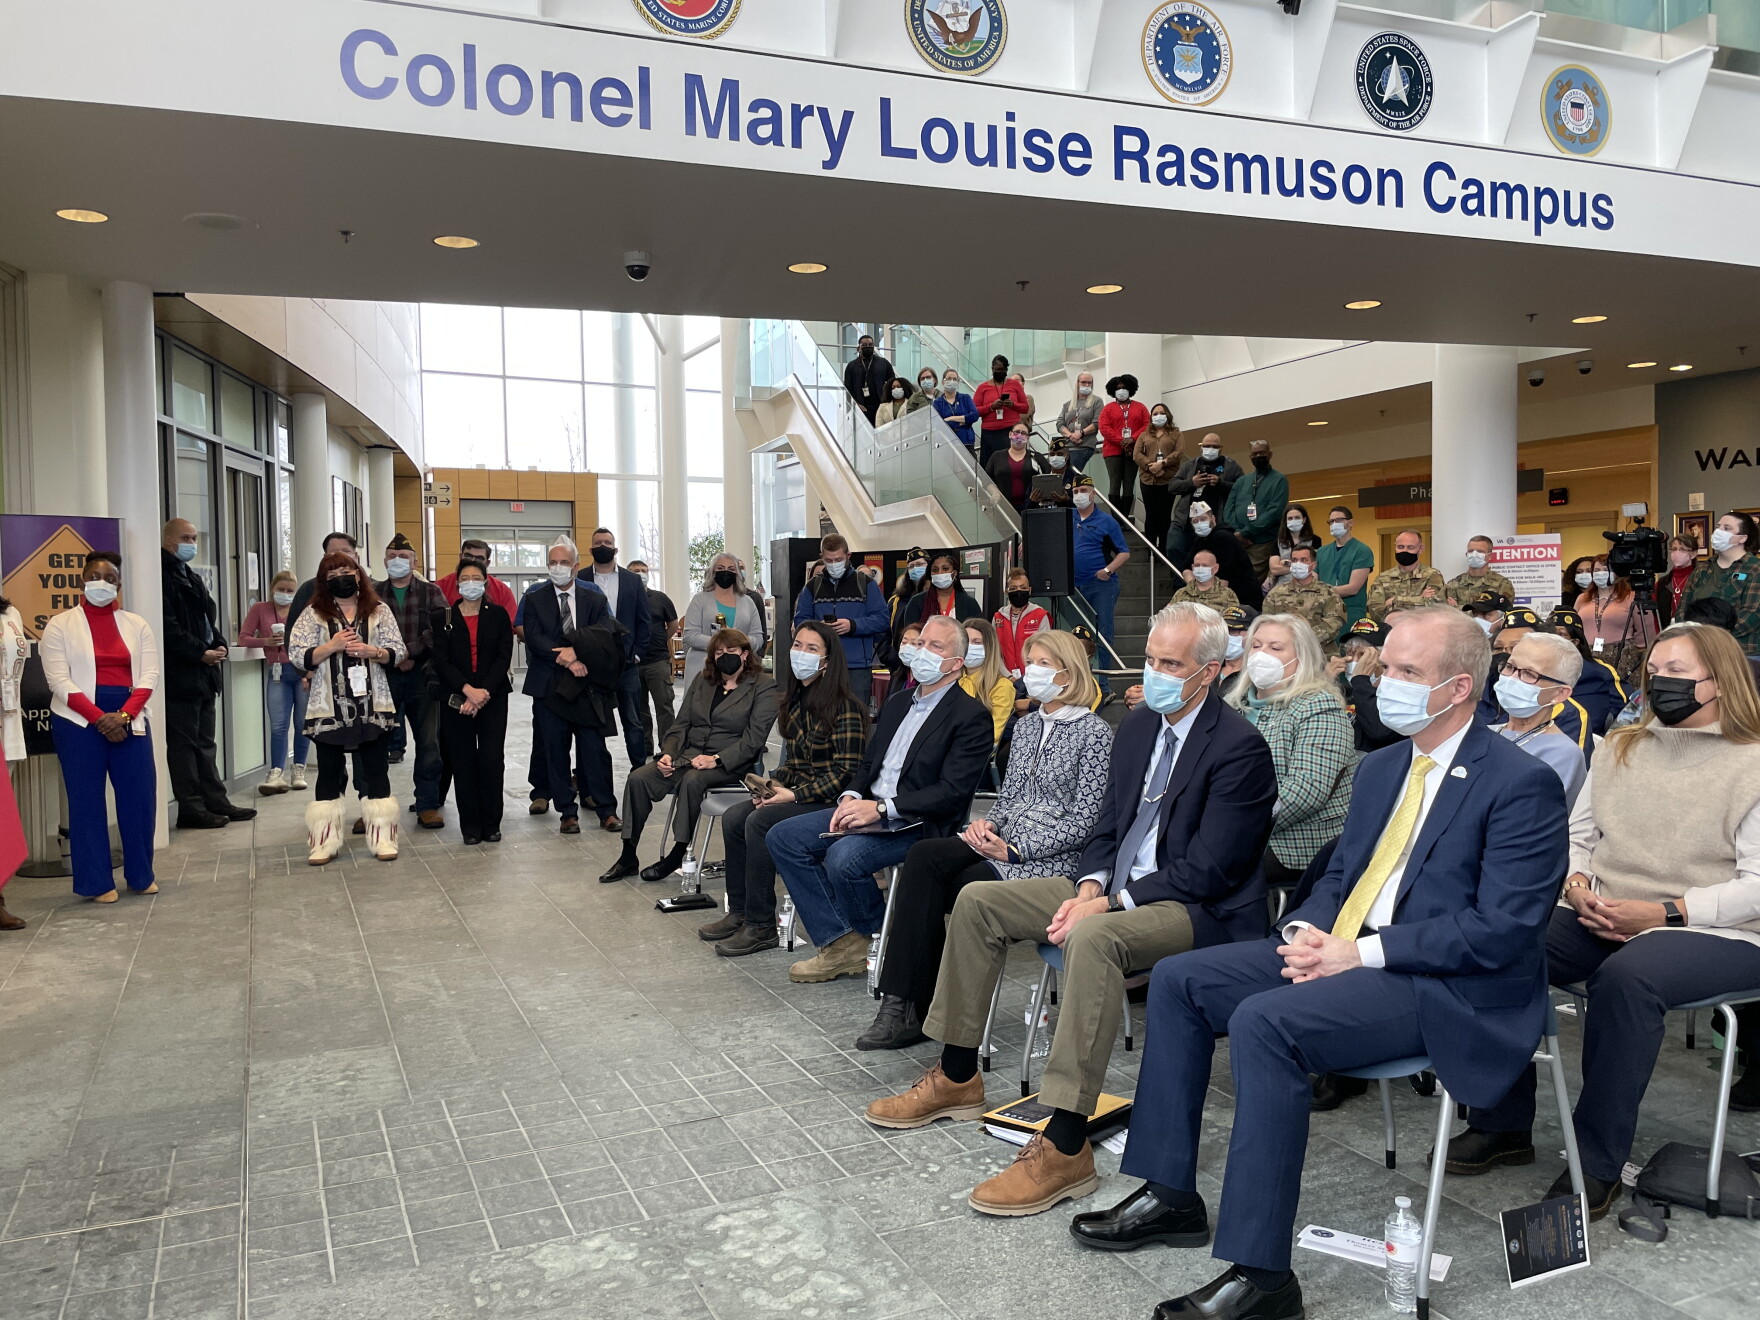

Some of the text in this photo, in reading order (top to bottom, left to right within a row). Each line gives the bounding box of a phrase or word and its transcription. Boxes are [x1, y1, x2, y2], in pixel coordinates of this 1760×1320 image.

[658, 11, 685, 29] STATES
[688, 16, 718, 30] MARINE
[913, 21, 999, 69] UNITED STATES OF AMERICA
[1145, 3, 1231, 75] DEPARTMENT OF THE AIR FORCE
[1358, 35, 1432, 84] UNITED STATES SPACE FORCE
[1359, 85, 1431, 129] DEPARTMENT OF THE AIR FORCE
[339, 28, 1616, 238] Colonel Mary Louise Rasmuson Campus
[1410, 486, 1432, 499] Pha
[48, 553, 87, 569] GET
[1492, 546, 1558, 561] TENTION
[38, 573, 82, 589] YOU
